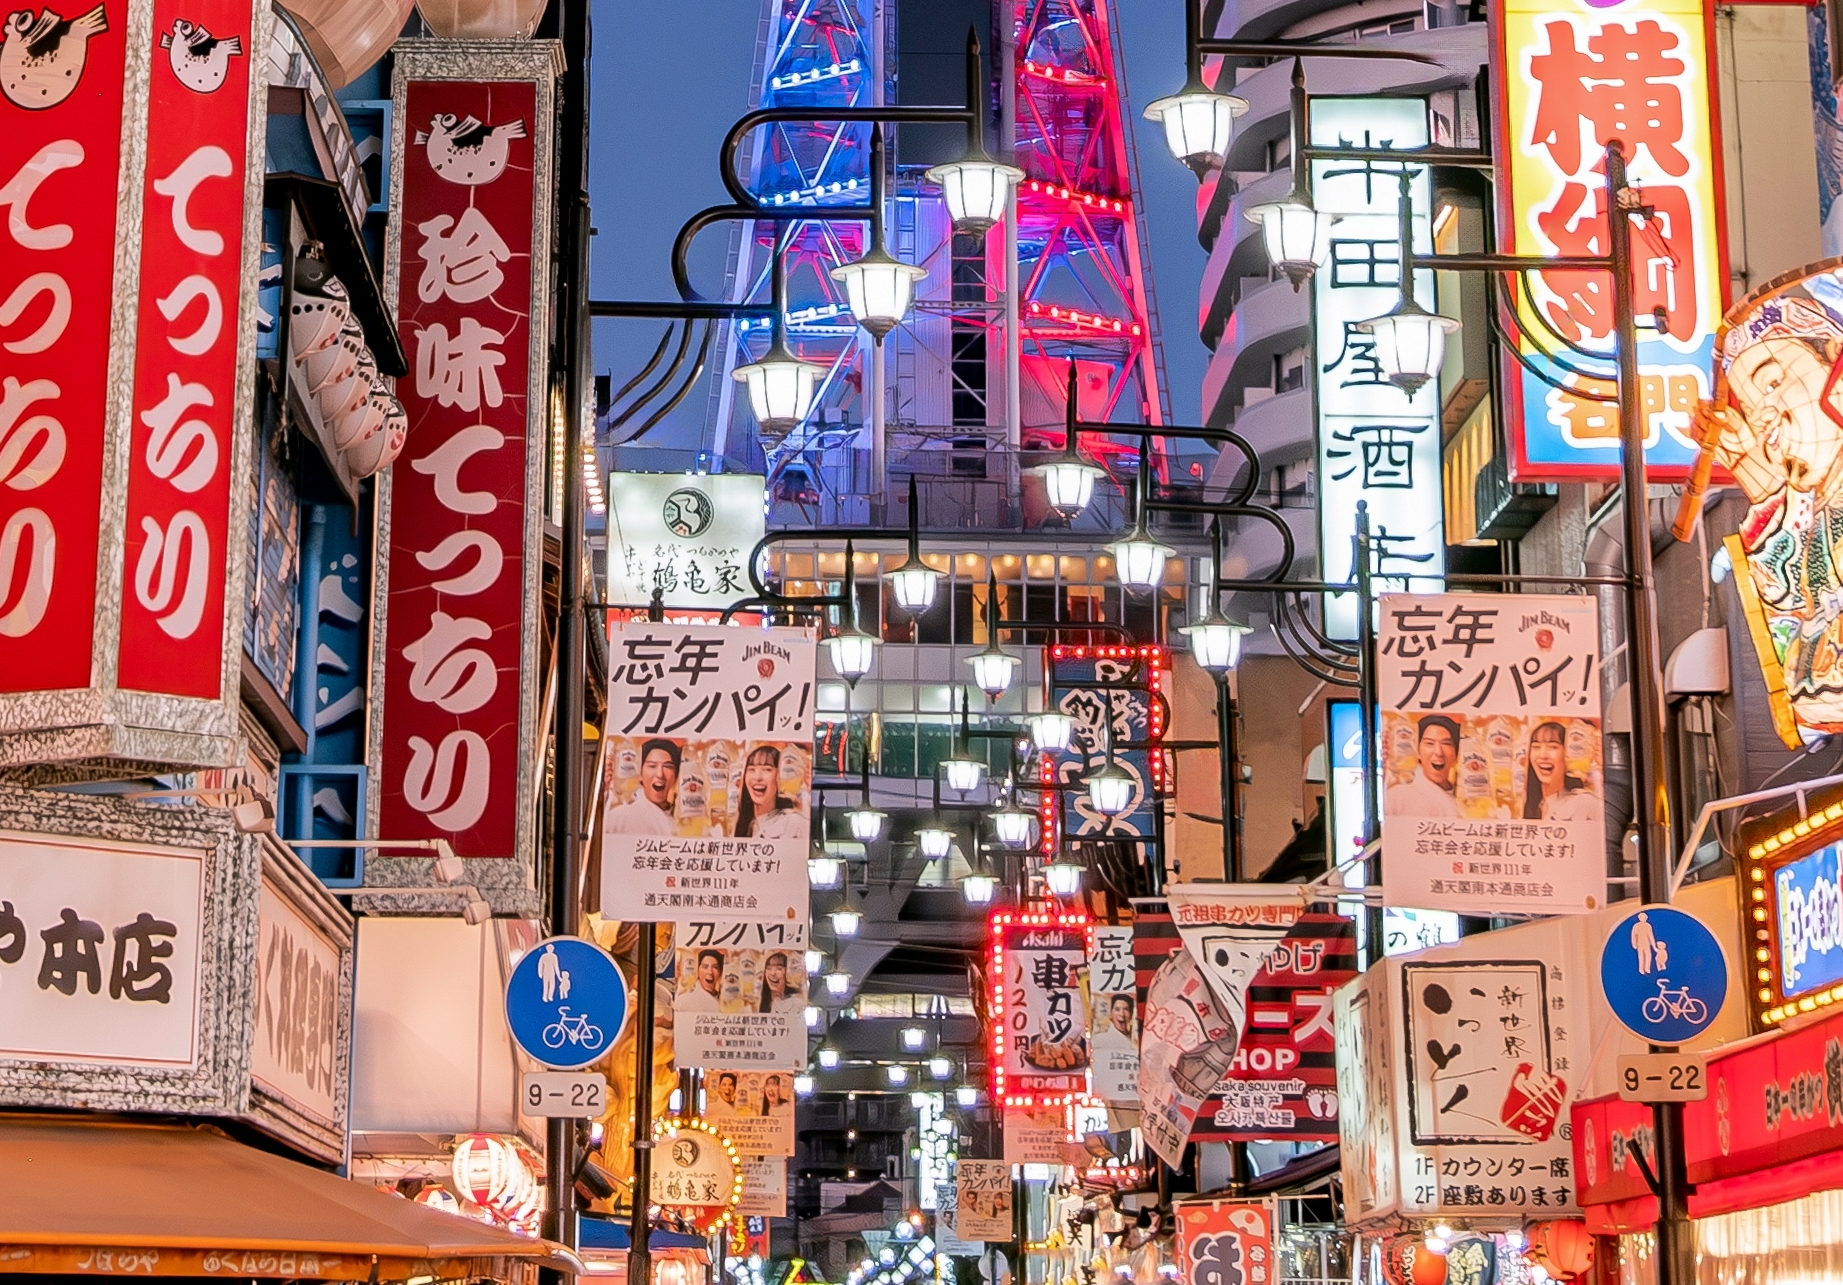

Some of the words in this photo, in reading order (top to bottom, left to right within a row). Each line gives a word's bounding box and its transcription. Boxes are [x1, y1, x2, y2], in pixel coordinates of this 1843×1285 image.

[1529, 18, 1698, 348] 横綱
[1381, 604, 1500, 659] 忘年
[1517, 613, 1540, 634] JIM
[1540, 610, 1571, 635] BEAM
[612, 634, 726, 687] 忘年
[741, 643, 762, 664] JIM
[762, 640, 792, 664] BEAM
[1416, 820, 1568, 841] ジムビームは新世界での
[635, 839, 776, 859] ジムビームは新世界での
[631, 854, 782, 876] 忘年会を応援しています!
[1021, 930, 1065, 948] Asahi
[1030, 952, 1073, 1044] 串カツ
[1211, 1079, 1246, 1093] saka
[1247, 1079, 1305, 1093] souvenir
[1415, 1157, 1435, 1177] 1F
[1441, 1156, 1573, 1179] カウンター席
[1414, 1186, 1436, 1206] 2F
[1441, 1185, 1573, 1207] 座敷あります
